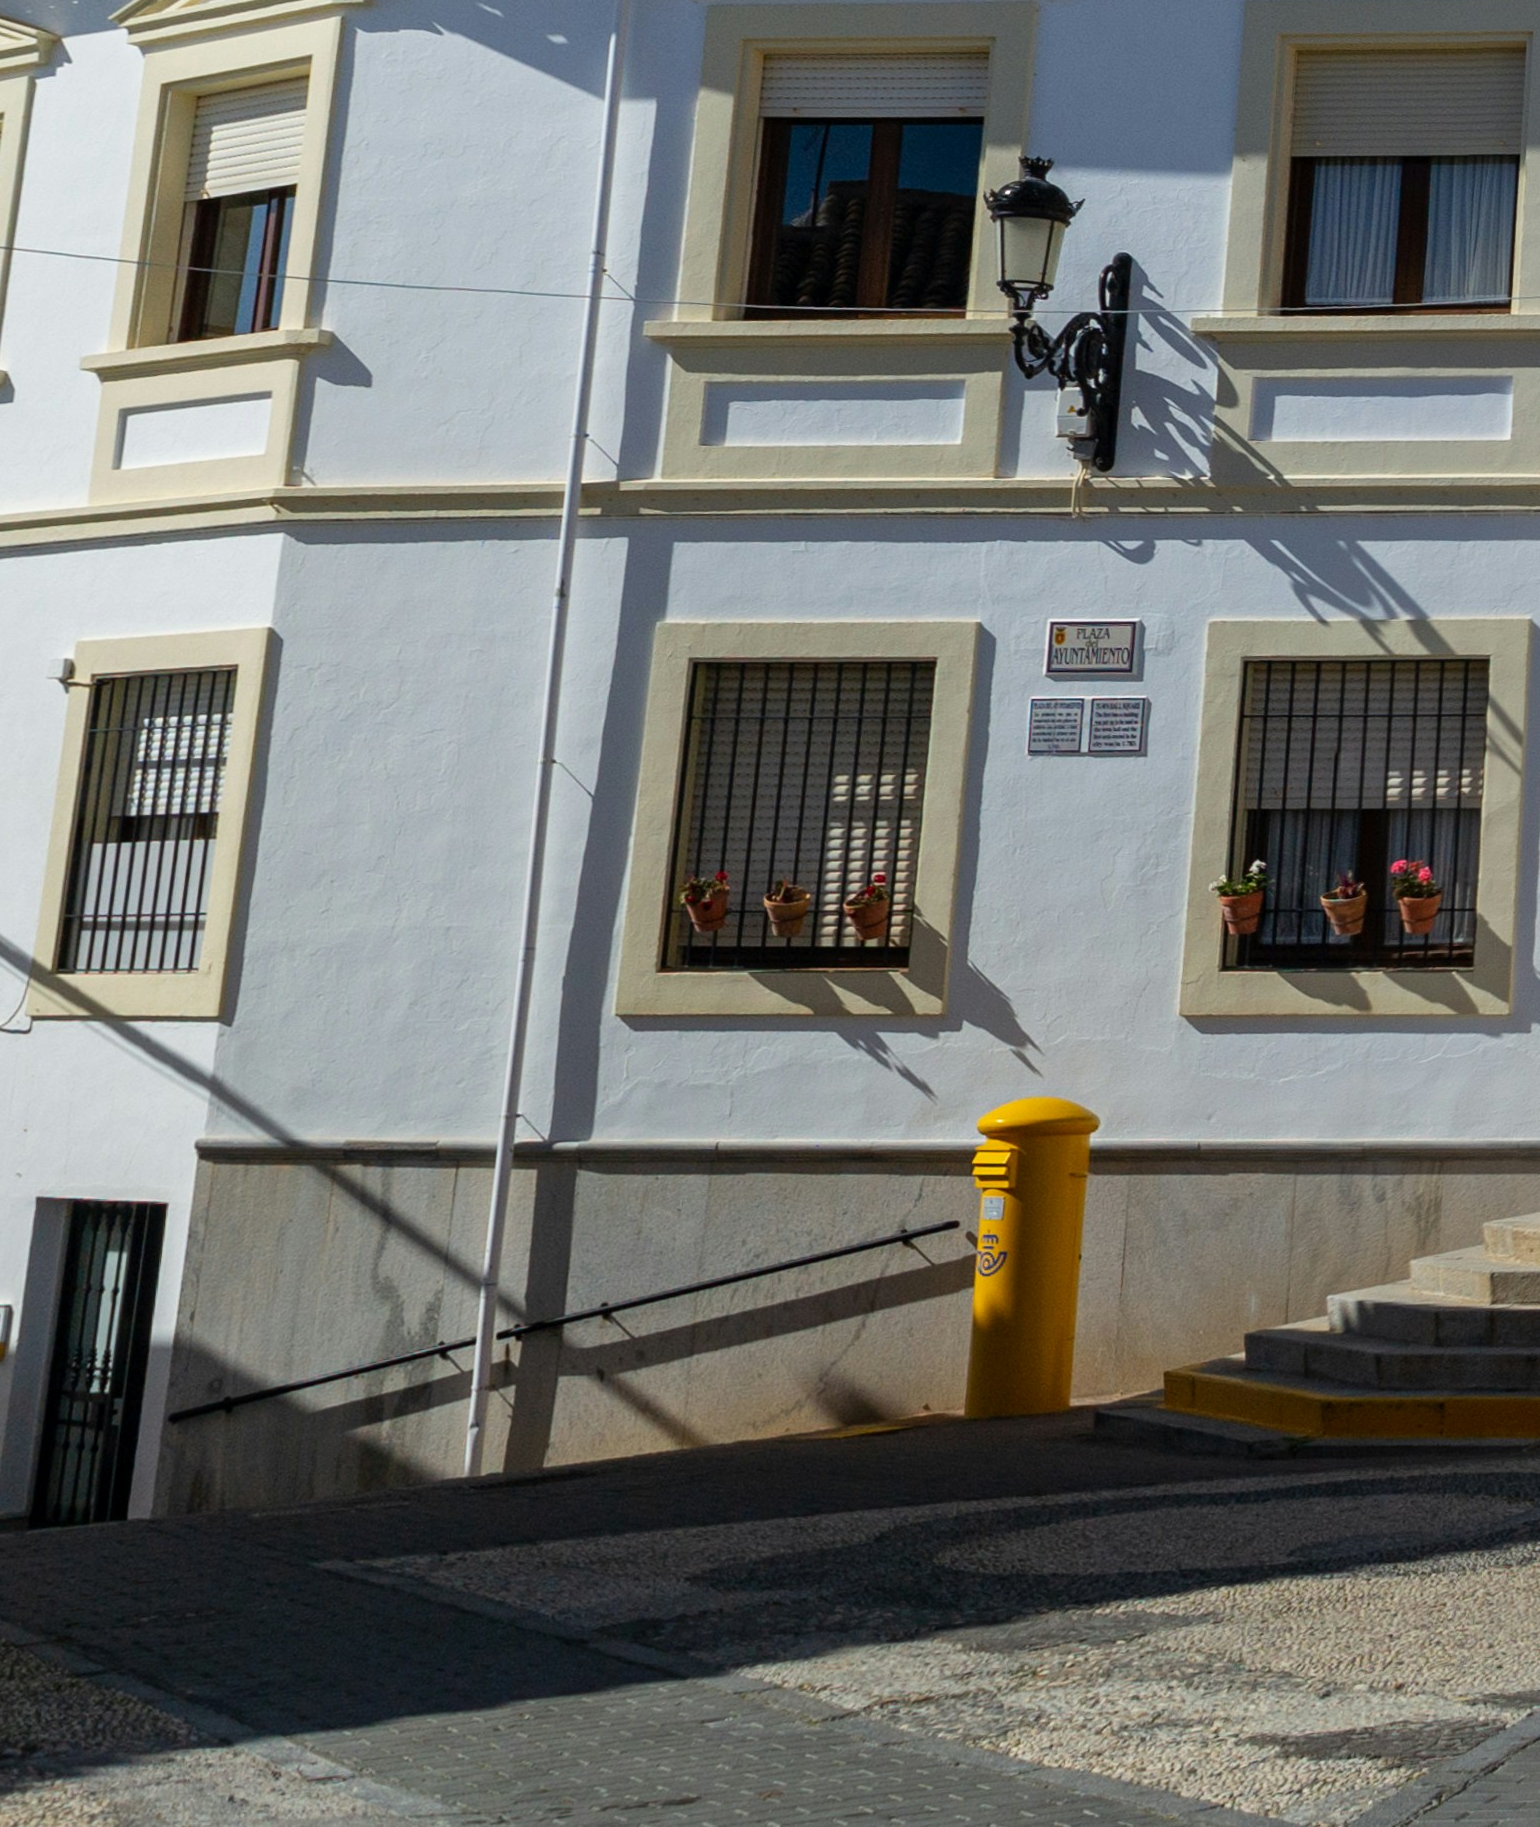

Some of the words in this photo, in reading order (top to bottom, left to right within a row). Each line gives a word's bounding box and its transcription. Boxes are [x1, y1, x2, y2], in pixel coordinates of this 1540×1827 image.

[1076, 628, 1110, 640] PLAZA
[1085, 639, 1098, 648] del
[1052, 647, 1130, 665] AYUNTAMIENTO
